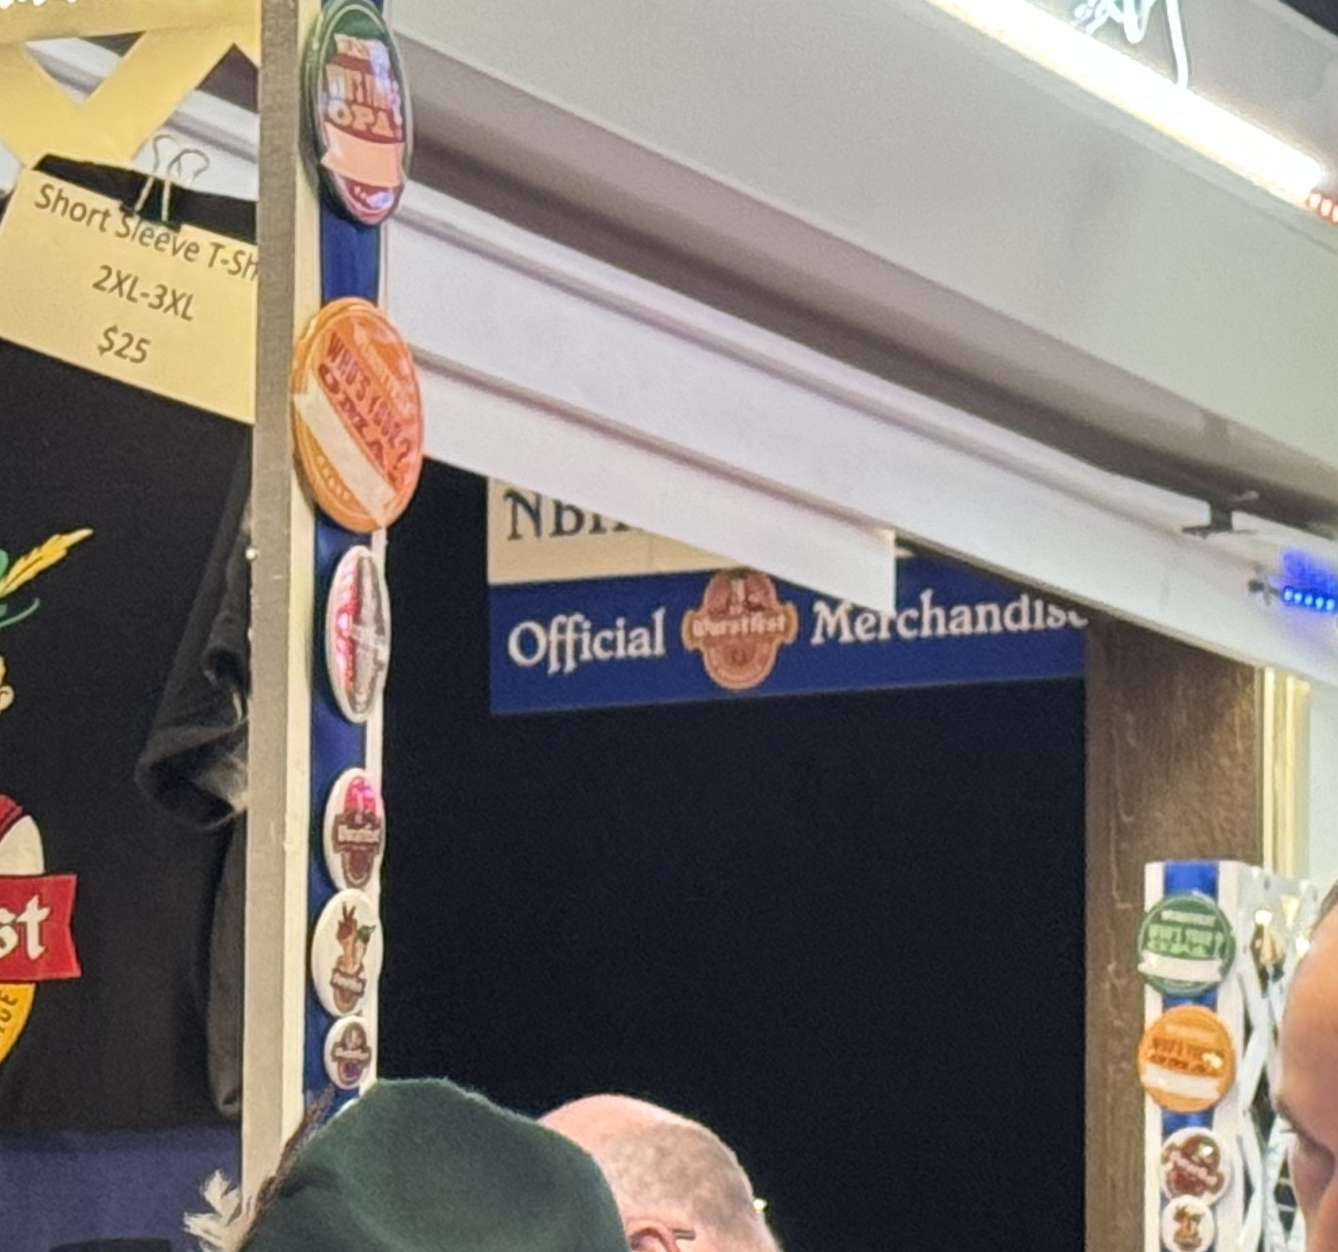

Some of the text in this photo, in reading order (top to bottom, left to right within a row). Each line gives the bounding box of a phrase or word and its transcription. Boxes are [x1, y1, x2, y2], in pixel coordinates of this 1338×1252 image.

[34, 183, 109, 232] Short
[116, 212, 200, 262] Sleeve
[92, 265, 194, 321] 2XL-3XL
[97, 325, 151, 364] $25
[507, 608, 666, 675] Official
